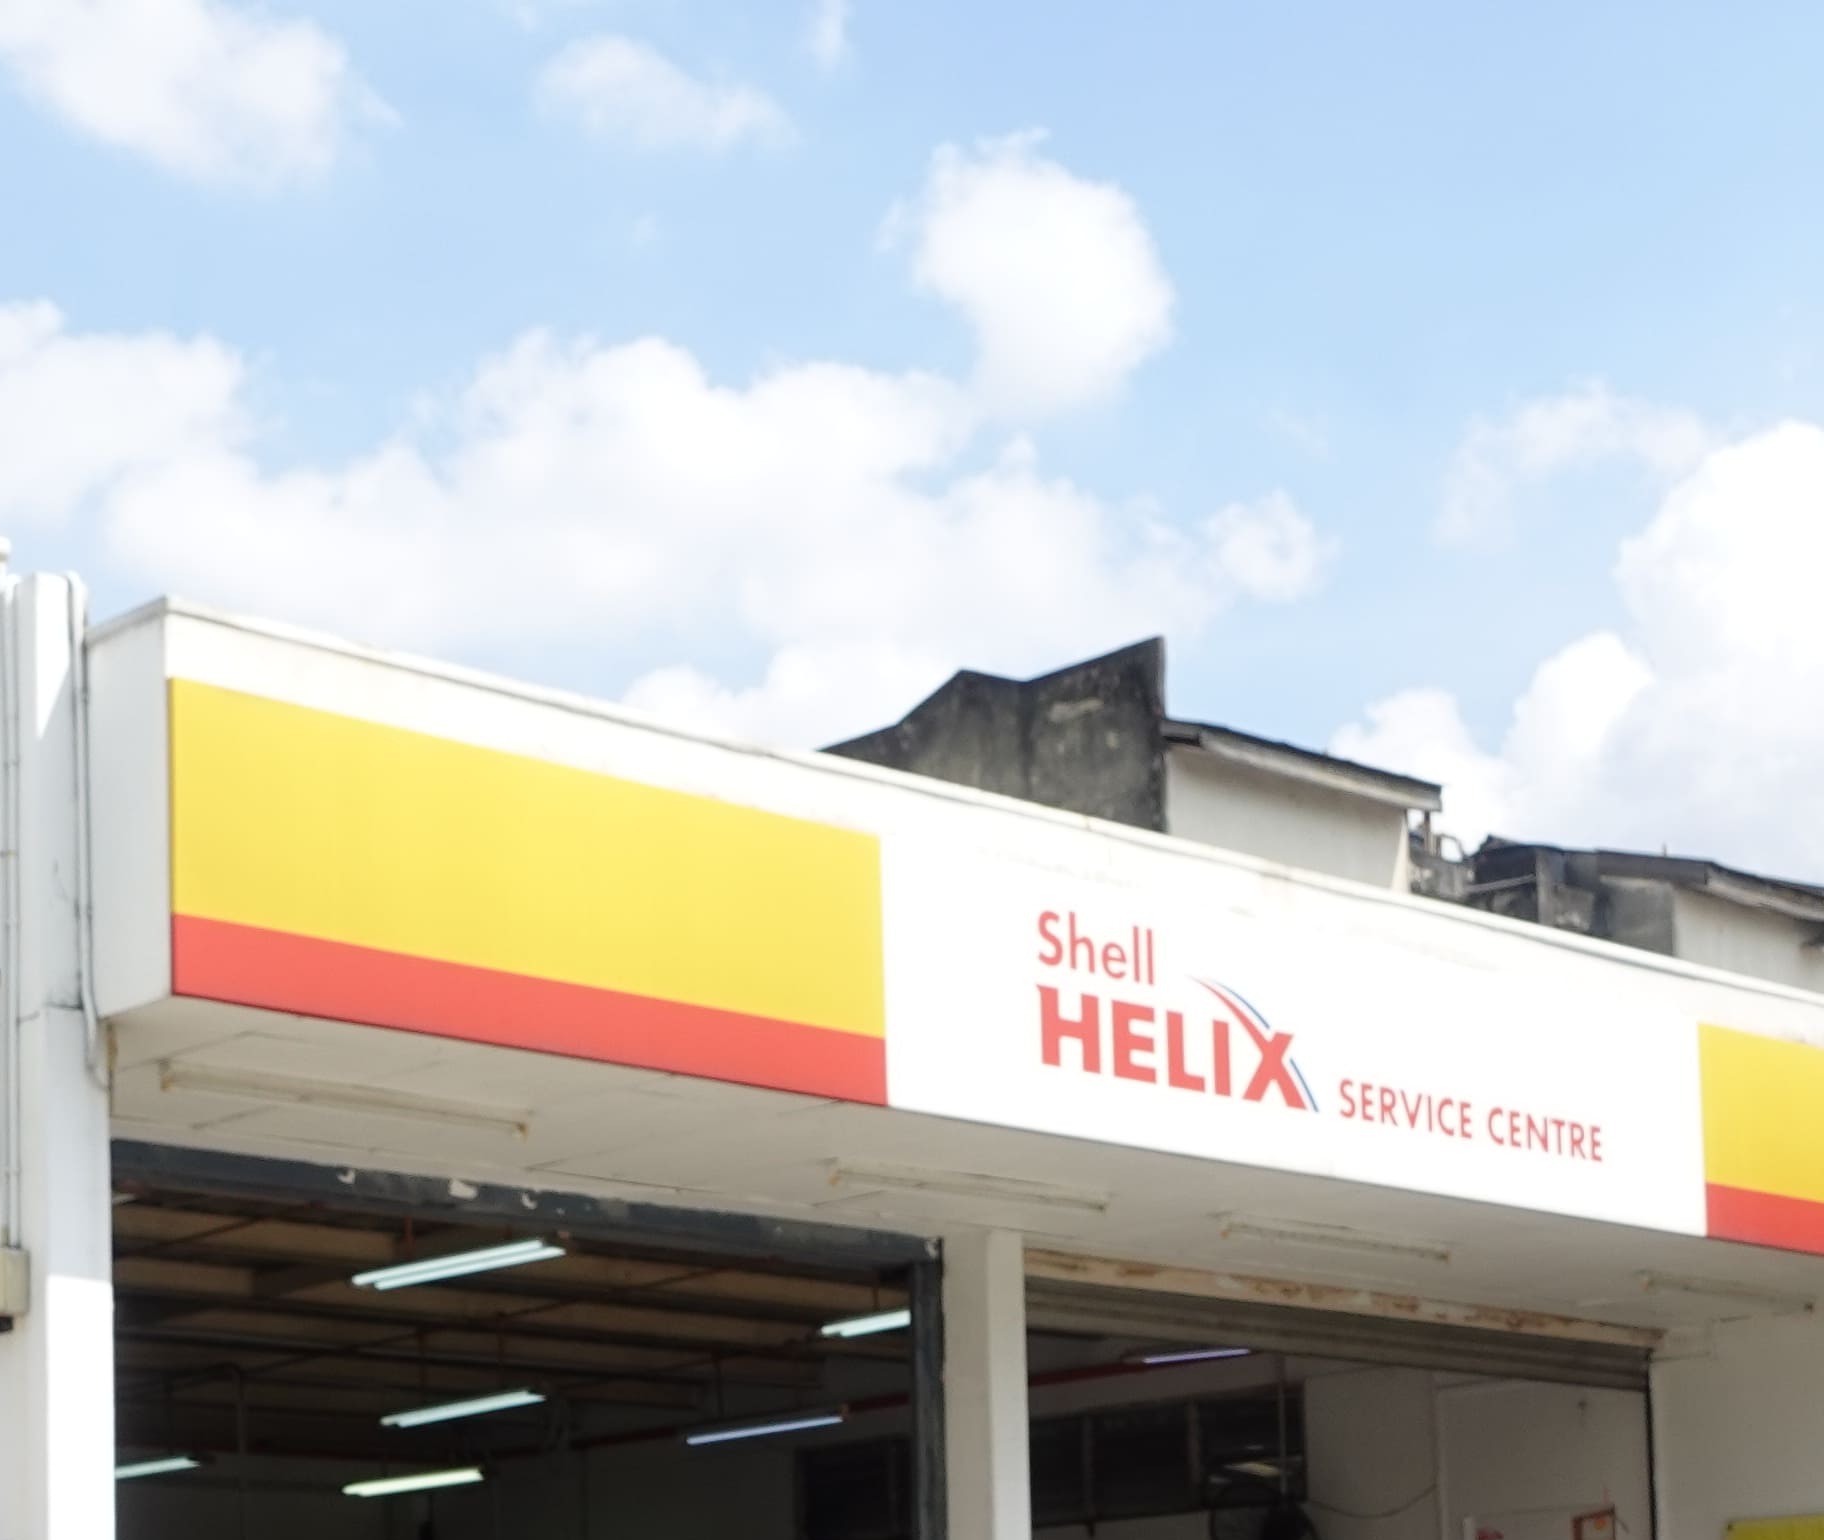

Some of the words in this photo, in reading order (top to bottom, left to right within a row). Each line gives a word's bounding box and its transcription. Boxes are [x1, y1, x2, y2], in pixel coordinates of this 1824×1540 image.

[1037, 910, 1155, 985] Shell
[1035, 978, 1314, 1112] HELIX
[1339, 1078, 1473, 1140] SERVICE
[1488, 1107, 1604, 1163] CENTRE
